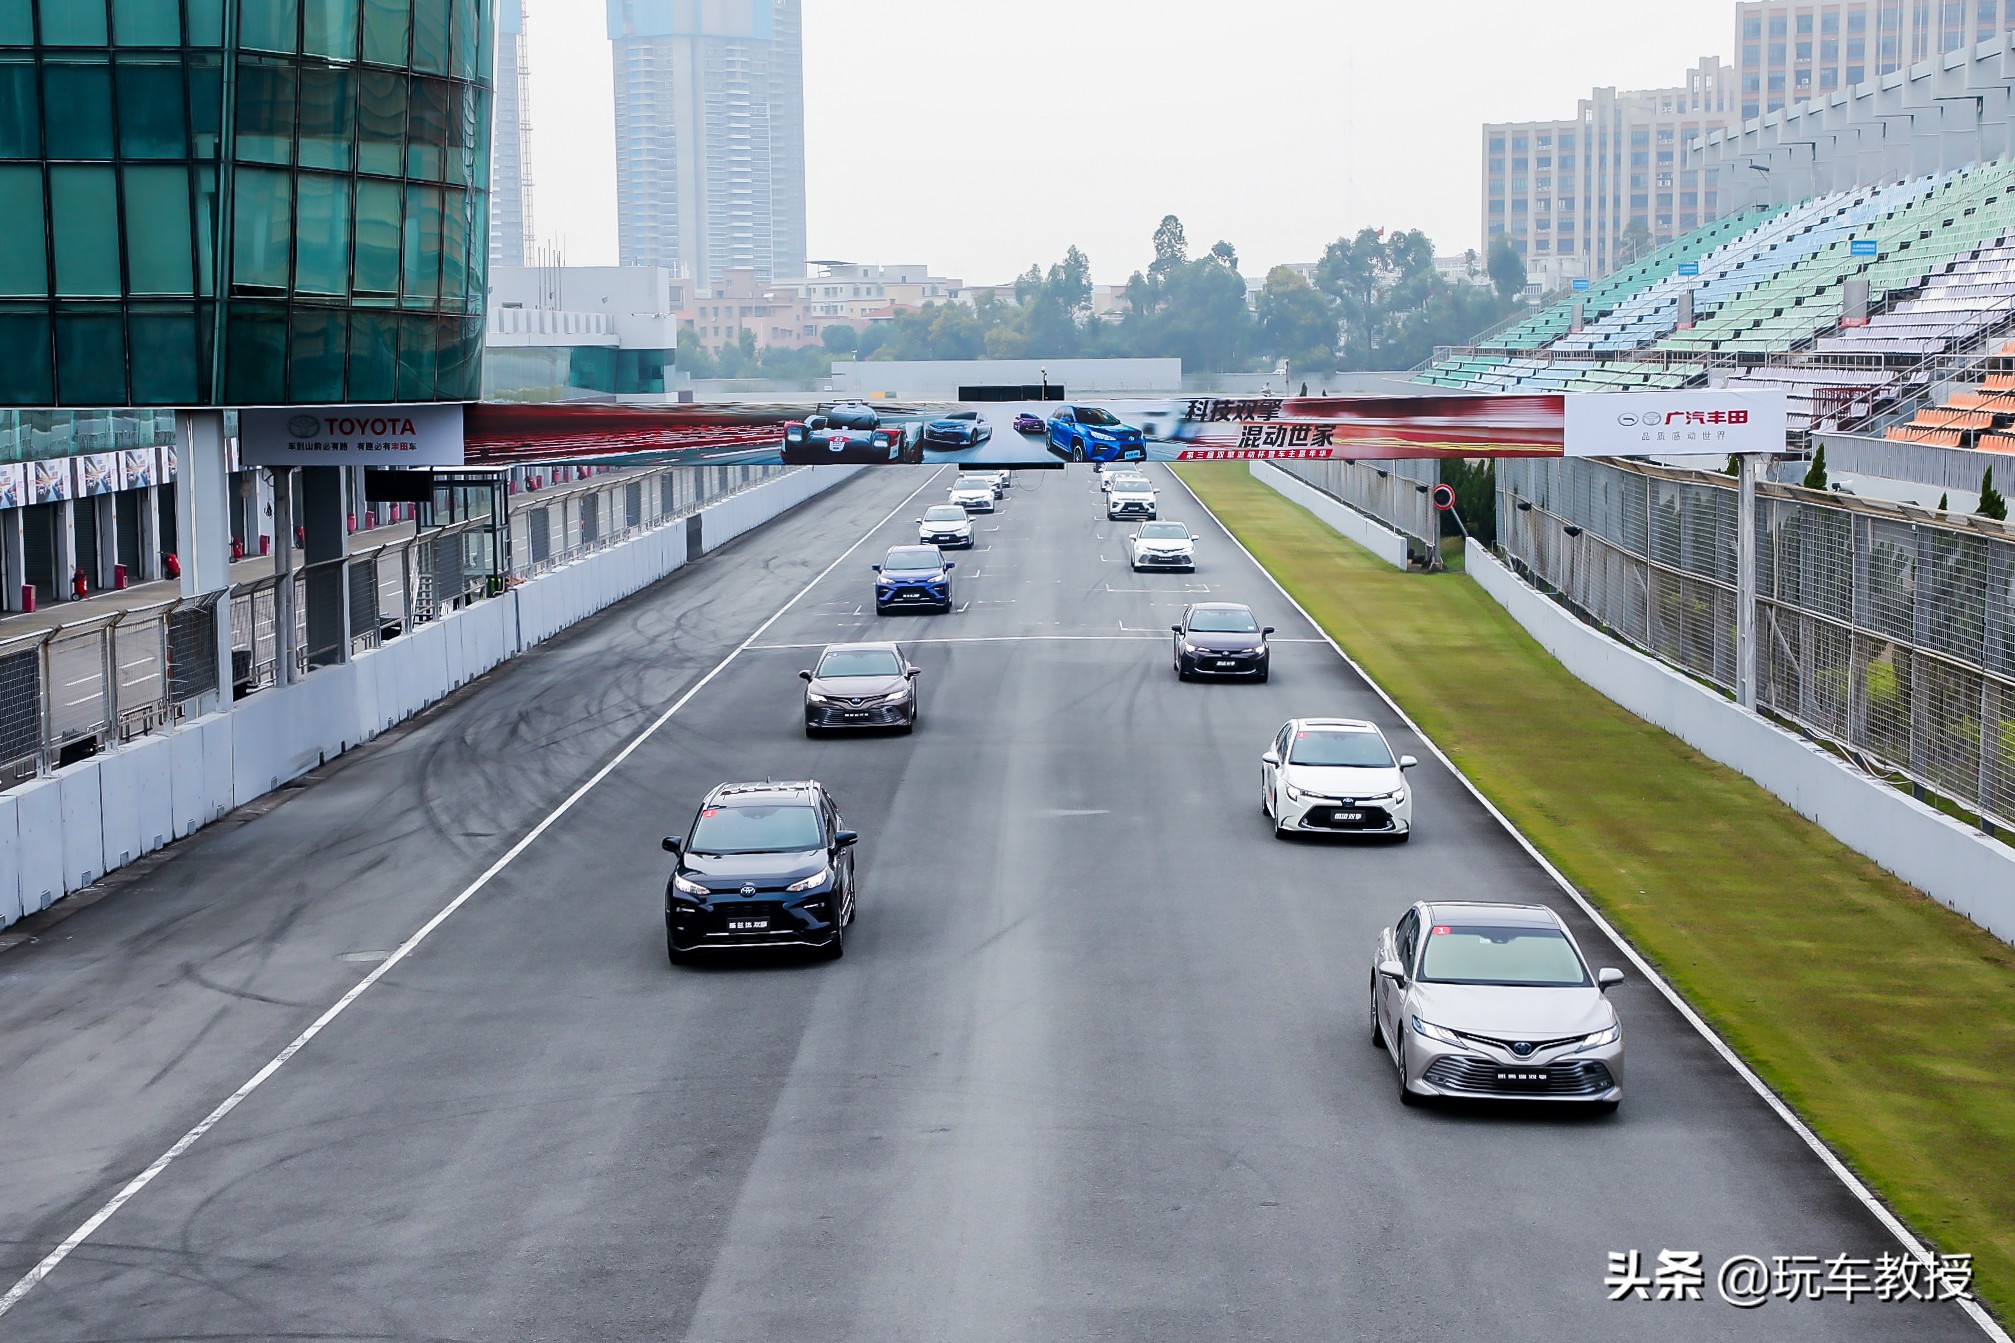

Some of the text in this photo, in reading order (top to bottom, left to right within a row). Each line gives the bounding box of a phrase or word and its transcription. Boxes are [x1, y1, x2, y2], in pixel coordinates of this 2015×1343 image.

[1185, 399, 1283, 422] 科技双擎
[1664, 409, 1749, 425] 广汽丰田
[324, 418, 417, 436] TOYOTA
[1238, 424, 1337, 448] 混动世家
[1641, 431, 1726, 441] 品质感动世界
[288, 442, 417, 451] 车到山前必有路 有路必有丰田车
